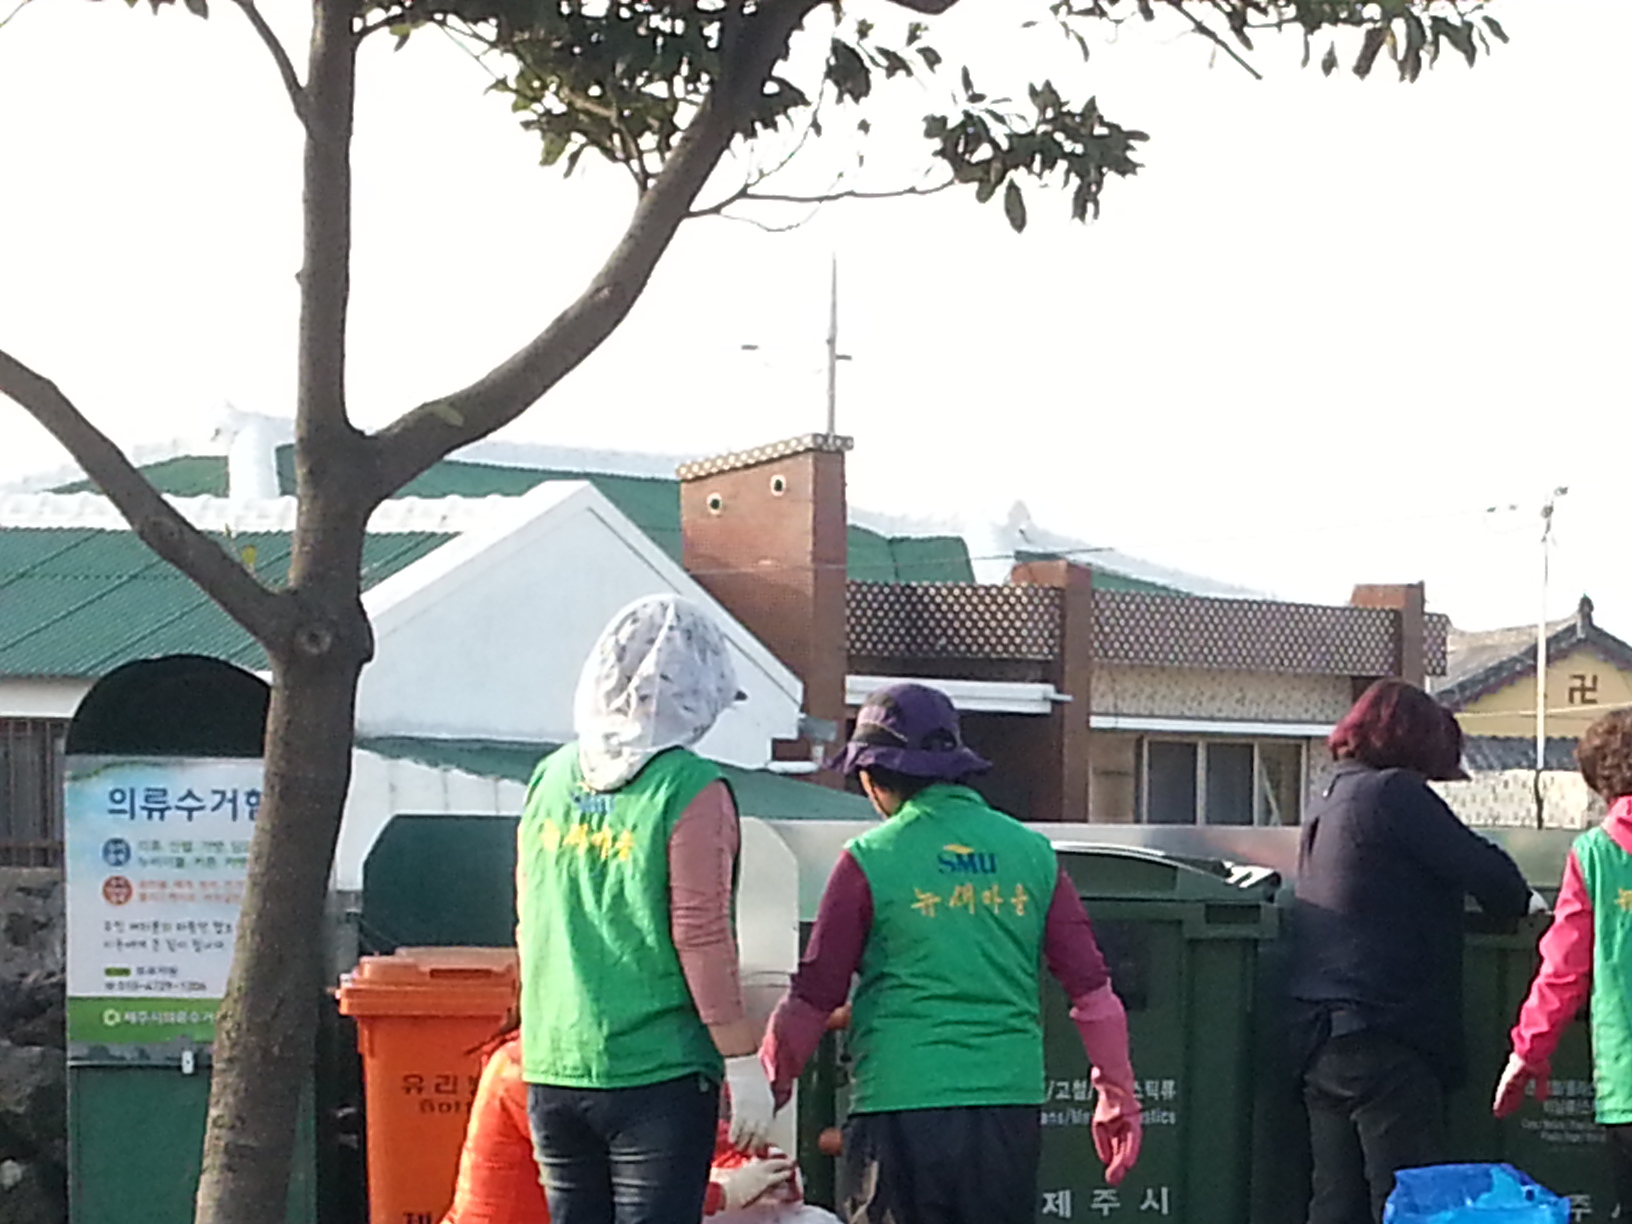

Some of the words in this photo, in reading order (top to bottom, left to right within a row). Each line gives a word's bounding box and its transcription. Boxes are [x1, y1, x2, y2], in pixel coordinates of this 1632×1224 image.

[937, 851, 997, 874] SMU
[911, 883, 1028, 918] 뉴새마을
[1041, 1187, 1170, 1219] 제주시
